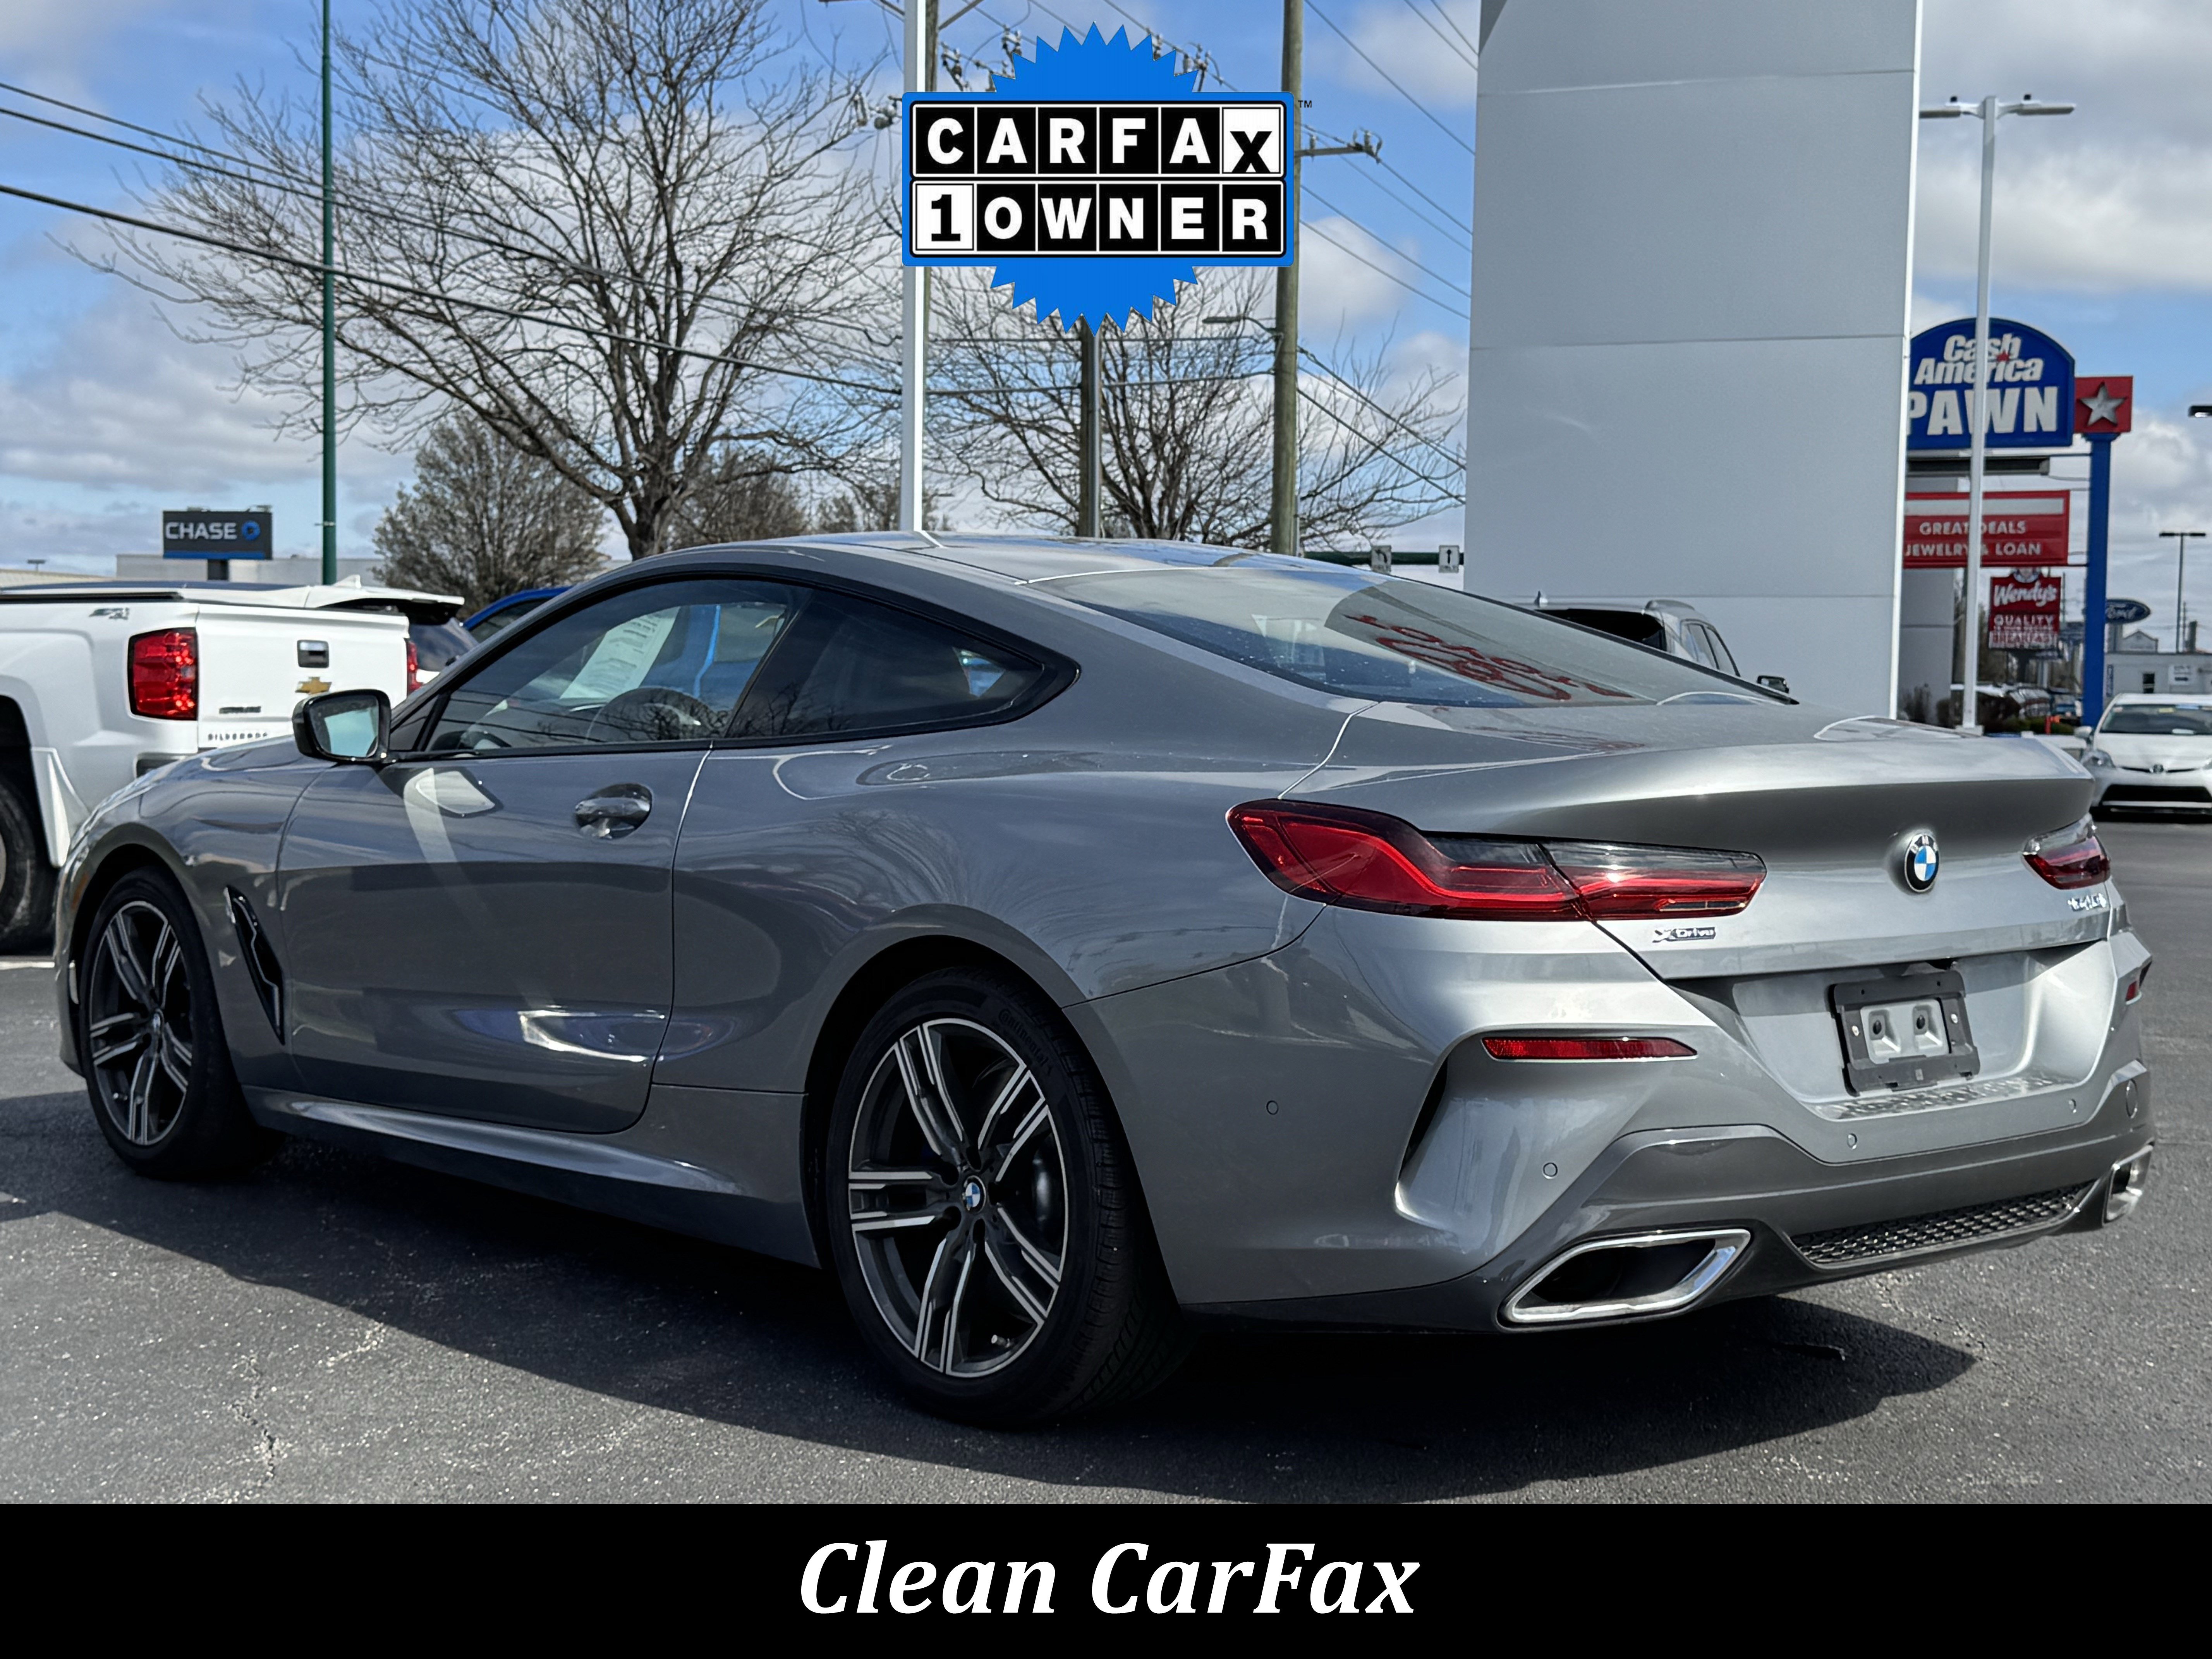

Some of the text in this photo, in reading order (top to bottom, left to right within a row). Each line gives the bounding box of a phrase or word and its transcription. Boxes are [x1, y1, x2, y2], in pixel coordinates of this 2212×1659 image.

[1944, 333, 2021, 362] Cash
[1914, 358, 2044, 385] America
[1907, 386, 2058, 435] PAWN
[165, 522, 237, 539] CHASE
[1996, 542, 2041, 555] LOAN
[1994, 580, 2057, 607] Wendy's
[1994, 614, 2054, 627] QUALITY
